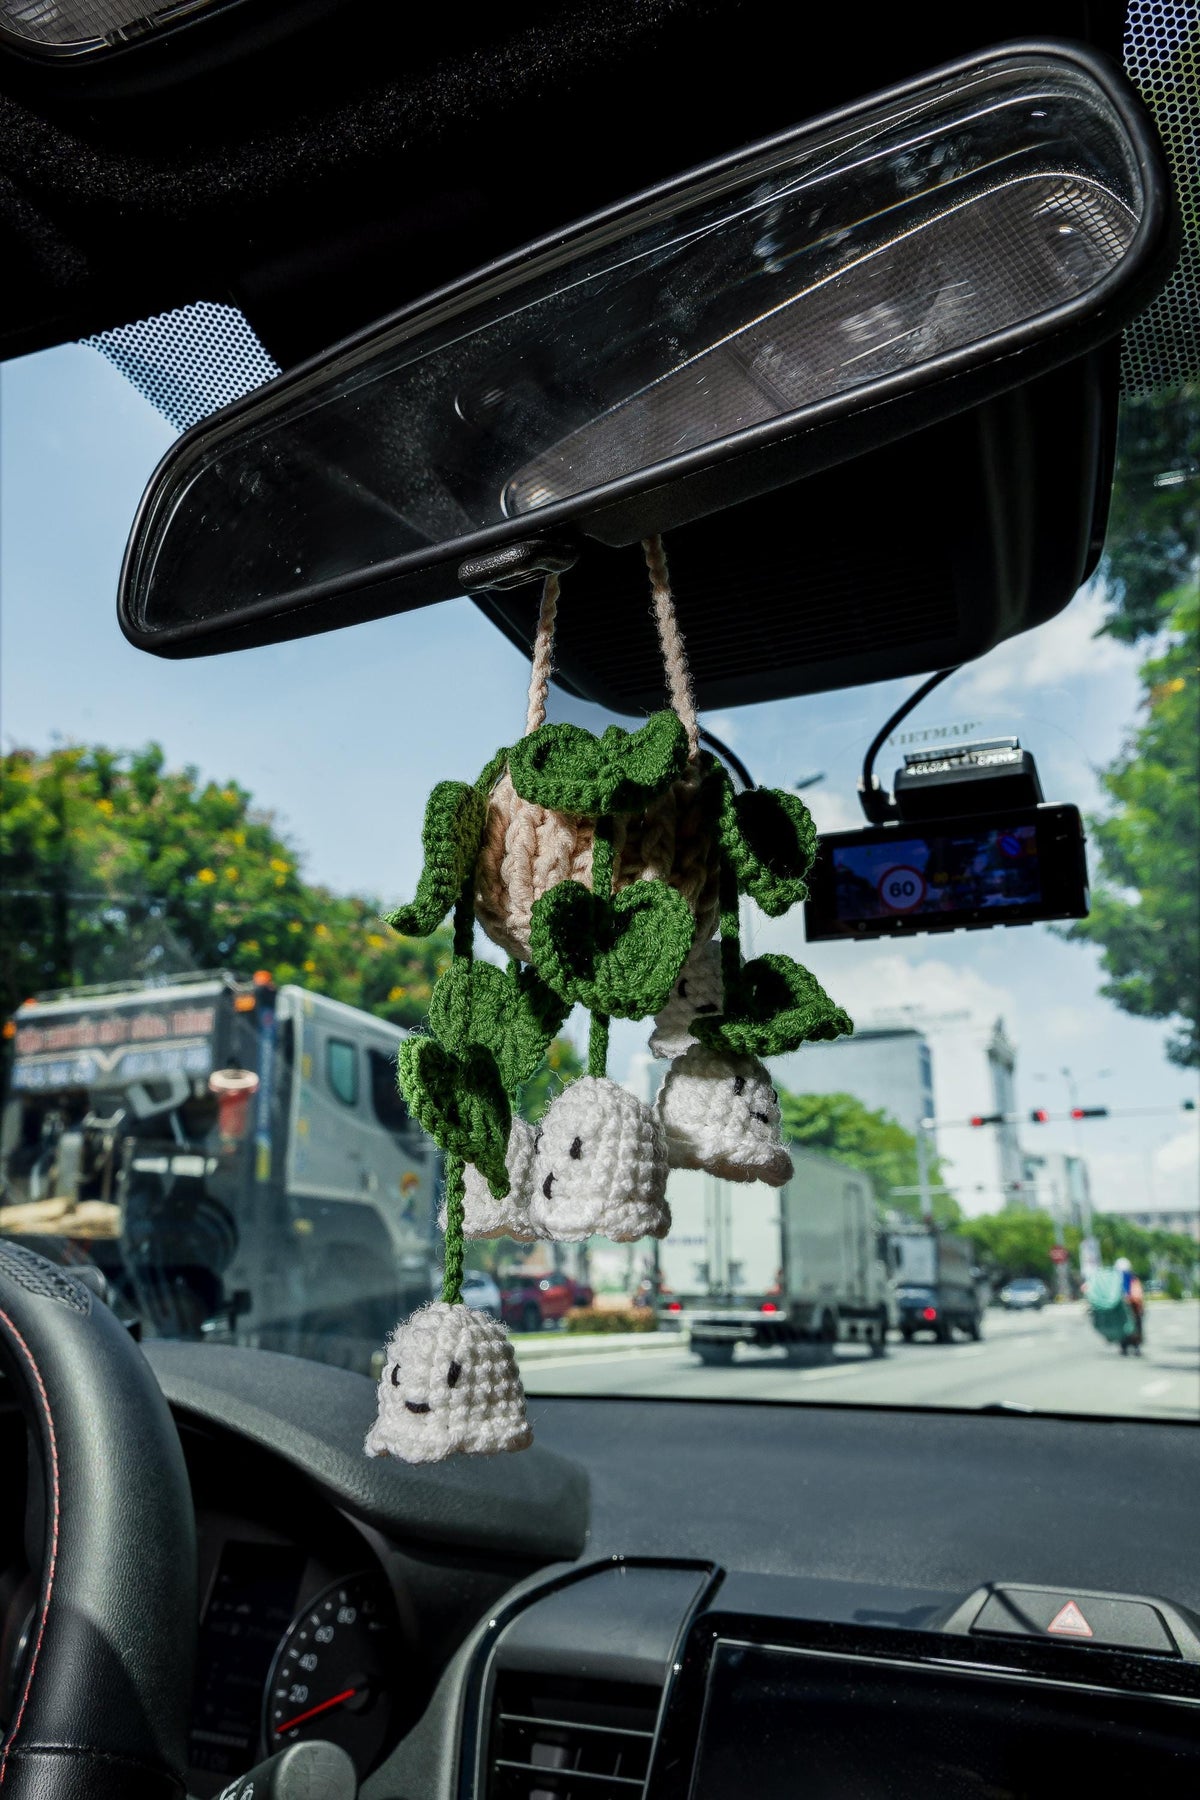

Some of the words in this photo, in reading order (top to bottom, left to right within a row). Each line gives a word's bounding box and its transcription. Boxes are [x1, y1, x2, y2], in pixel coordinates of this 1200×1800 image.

[889, 722, 975, 746] VIETMAP
[977, 753, 1009, 766] OPEN
[890, 880, 915, 897] 60
[299, 1653, 318, 1671] 40
[289, 1684, 309, 1703] 20
